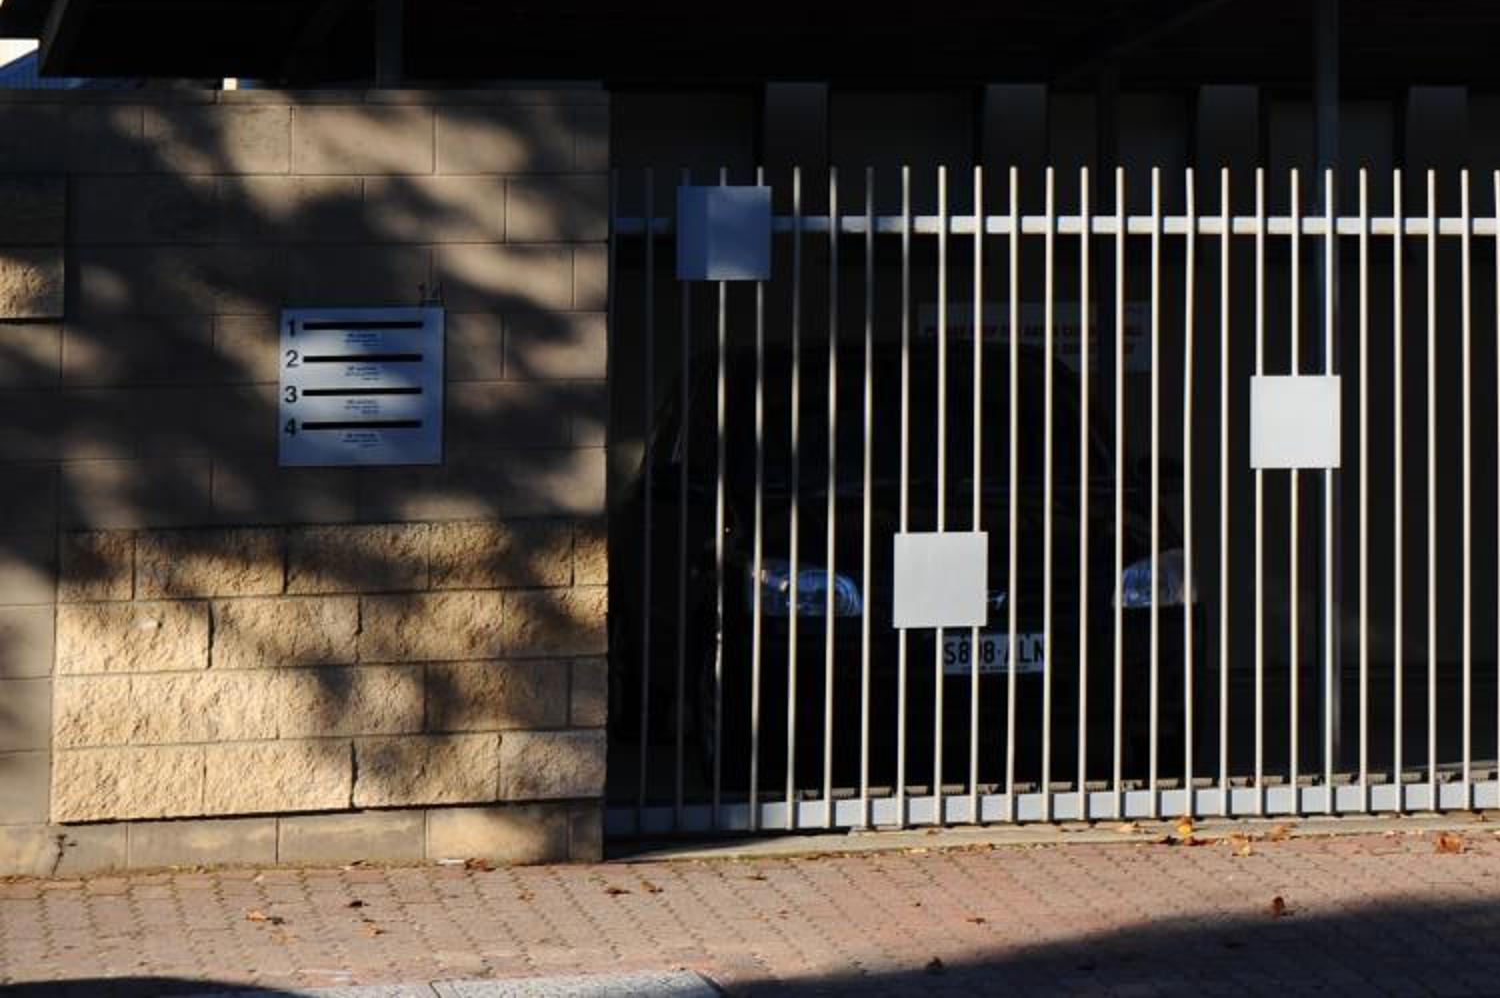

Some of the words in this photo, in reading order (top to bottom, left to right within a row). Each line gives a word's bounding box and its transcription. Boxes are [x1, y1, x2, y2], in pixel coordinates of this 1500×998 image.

[287, 320, 296, 337] 1
[286, 350, 298, 367] 2
[285, 386, 297, 403] 3
[285, 418, 297, 435] 4
